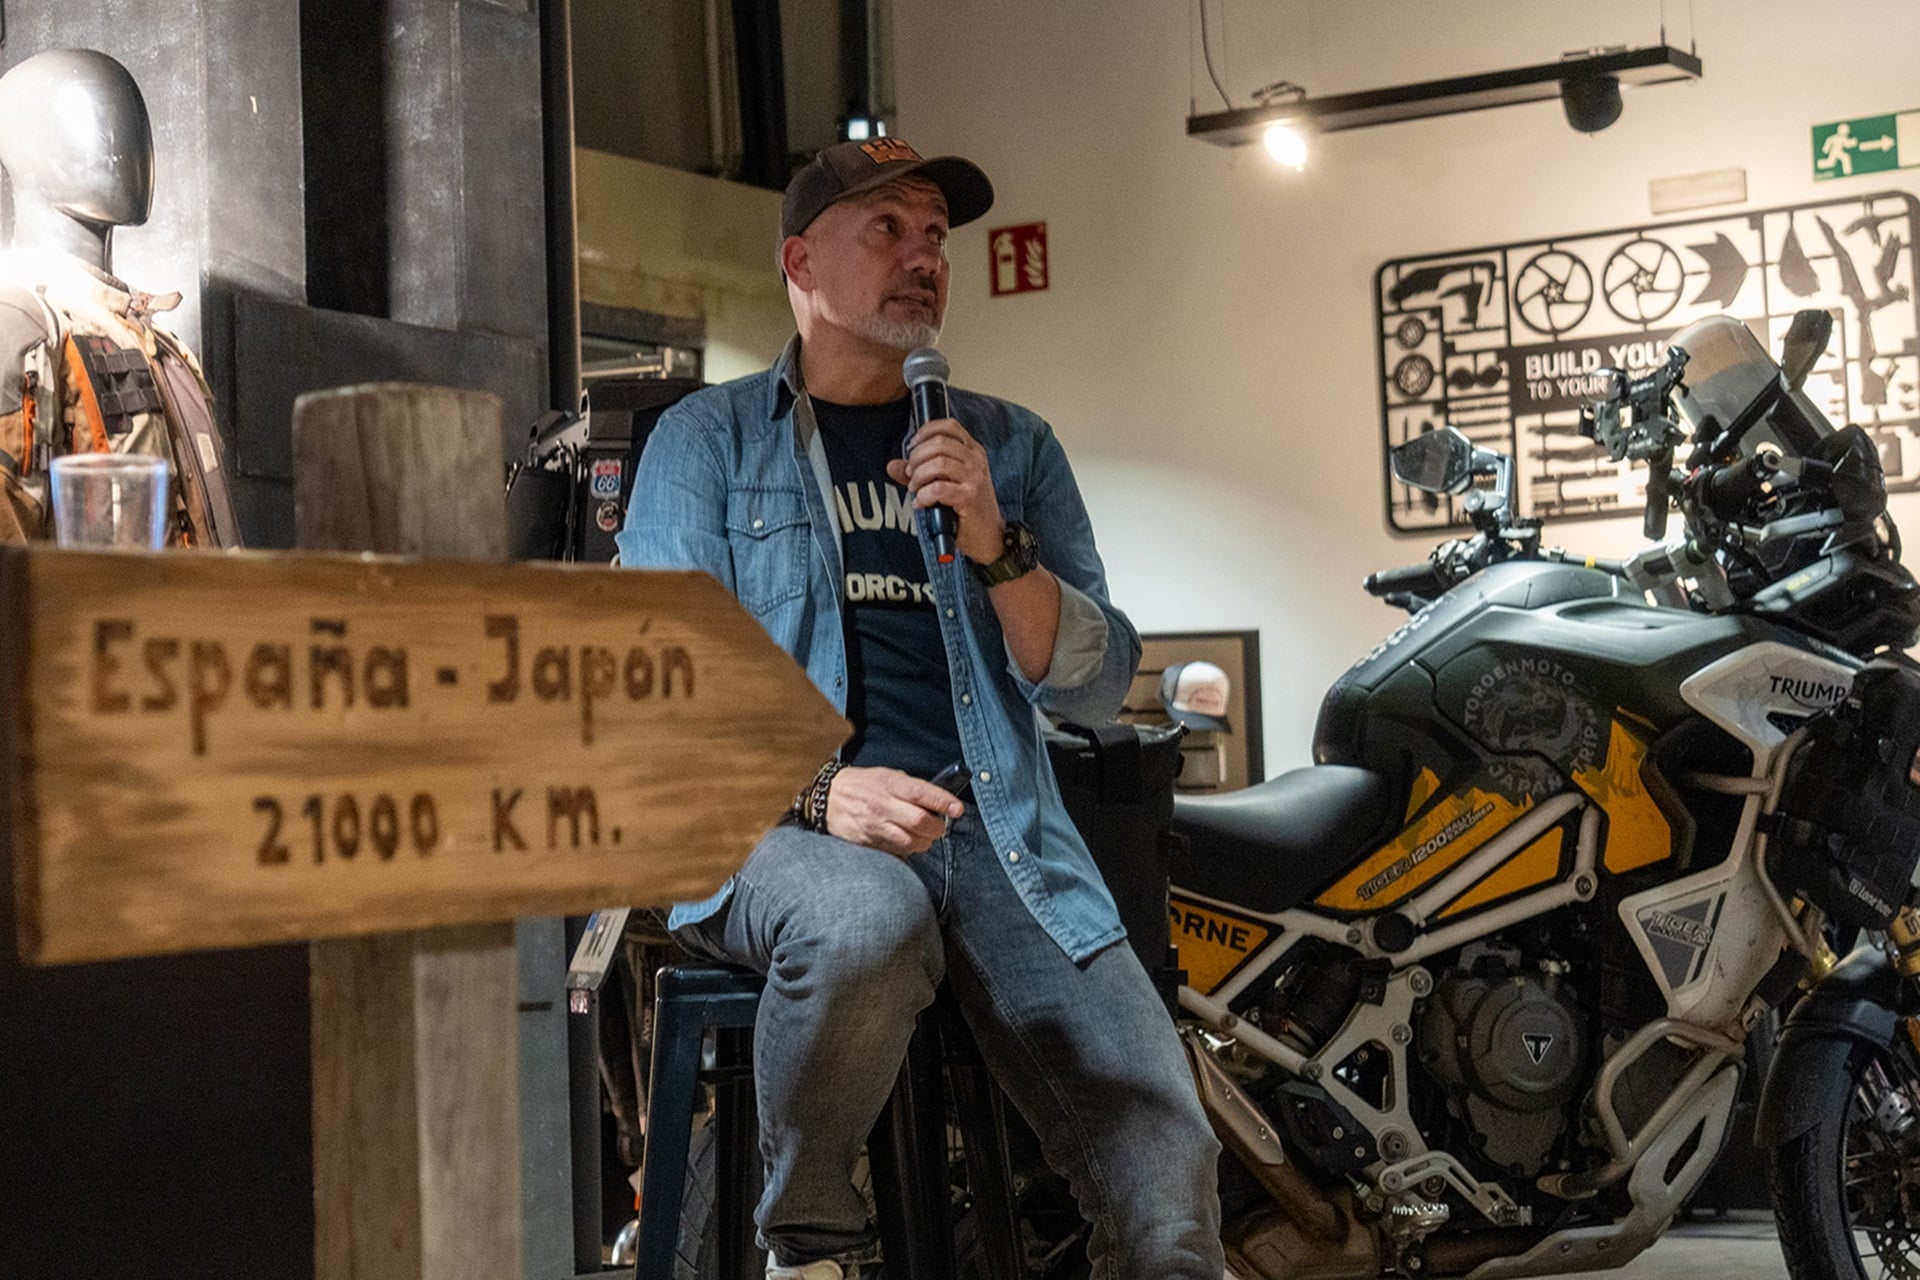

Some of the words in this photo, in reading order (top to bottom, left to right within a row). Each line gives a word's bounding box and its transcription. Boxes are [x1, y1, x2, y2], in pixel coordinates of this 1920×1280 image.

[1525, 348, 1602, 381] BUILD
[1608, 340, 1665, 370] YOU
[1527, 381, 1553, 401] TO
[1556, 375, 1609, 398] YOUR
[597, 475, 616, 491] 66
[834, 480, 919, 537] IUM
[90, 618, 409, 755] España
[484, 616, 697, 746] Japón
[1464, 658, 1575, 725] TOROENMOTO
[1770, 675, 1847, 709] TRIUMP
[253, 791, 440, 868] 21000
[1411, 832, 1447, 866] 1200
